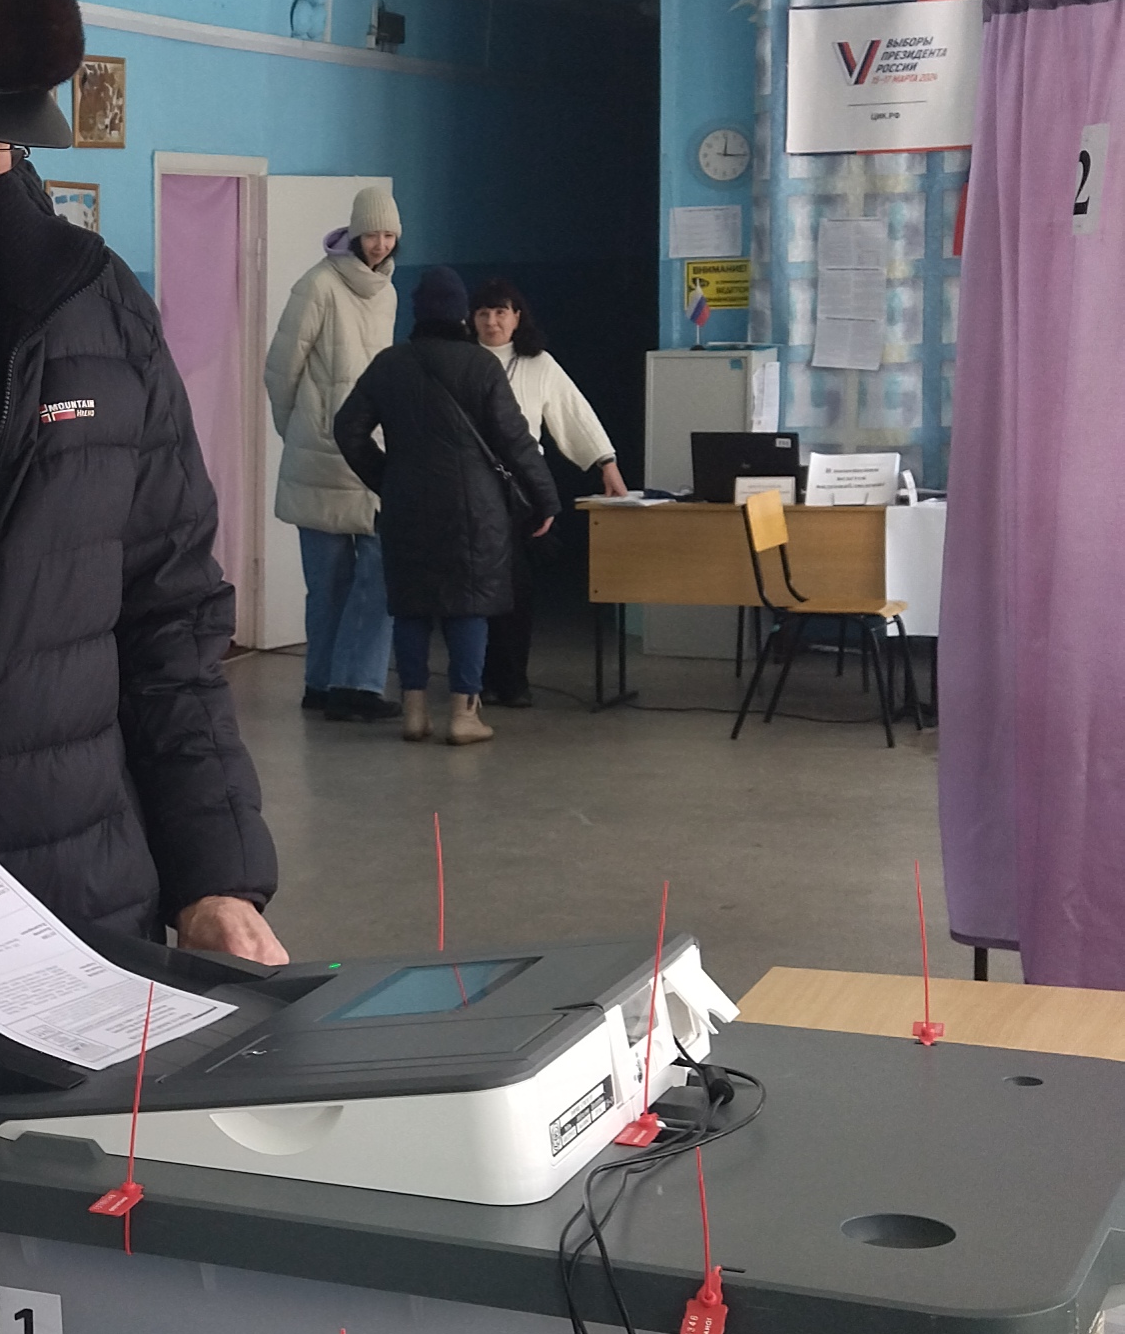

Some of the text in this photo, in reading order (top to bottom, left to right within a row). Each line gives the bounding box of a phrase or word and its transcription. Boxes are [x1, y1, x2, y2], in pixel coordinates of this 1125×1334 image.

[886, 37, 933, 48] ВЫБОРЫ
[880, 48, 948, 61] ПРЕЗИДЕНТА
[875, 62, 918, 73] РОССИИ
[1073, 150, 1091, 215] 2
